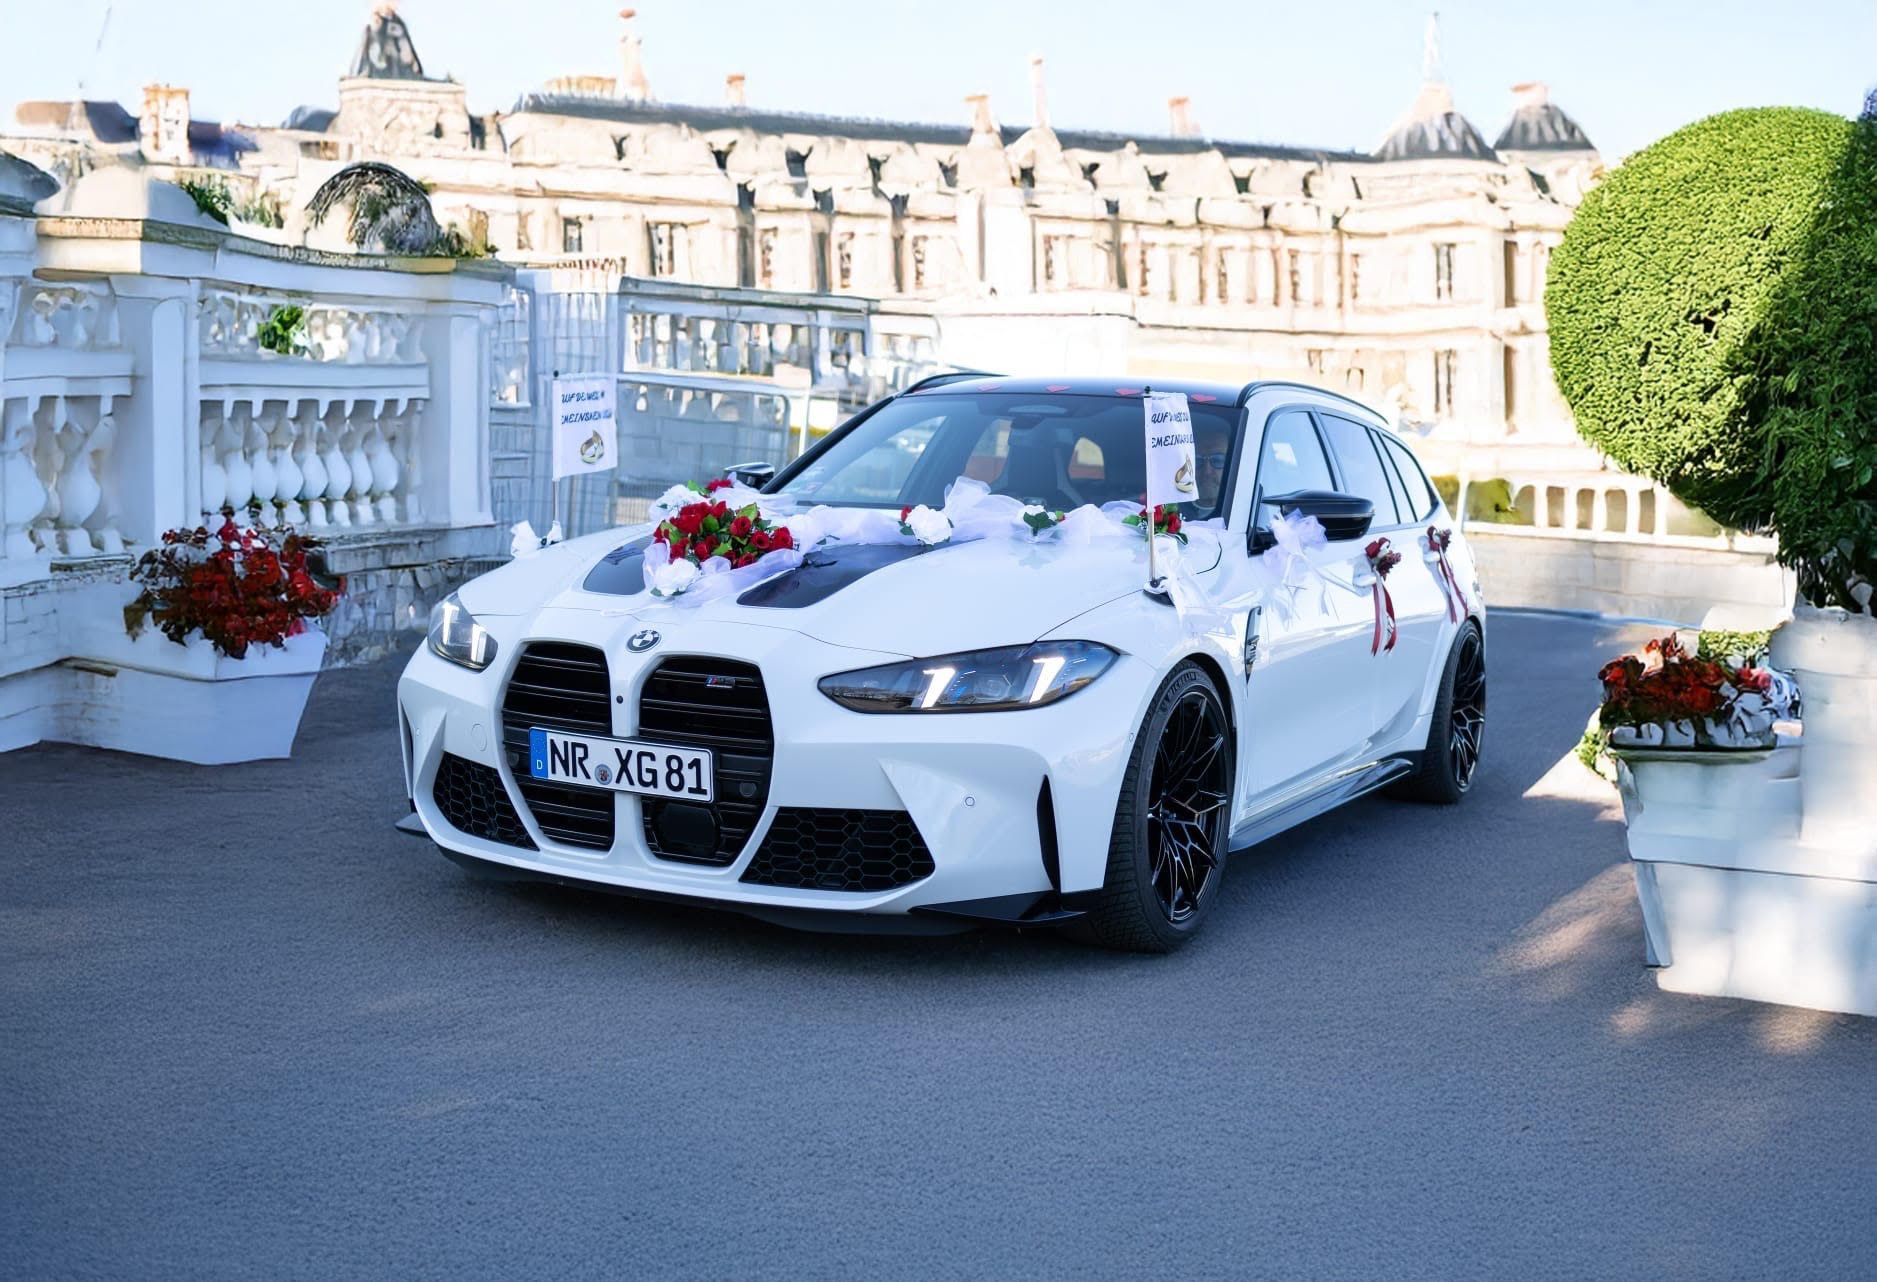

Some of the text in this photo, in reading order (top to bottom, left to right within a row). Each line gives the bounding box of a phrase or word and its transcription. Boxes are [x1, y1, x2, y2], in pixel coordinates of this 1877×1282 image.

[536, 759, 543, 770] D
[550, 738, 708, 796] NR XG 81
